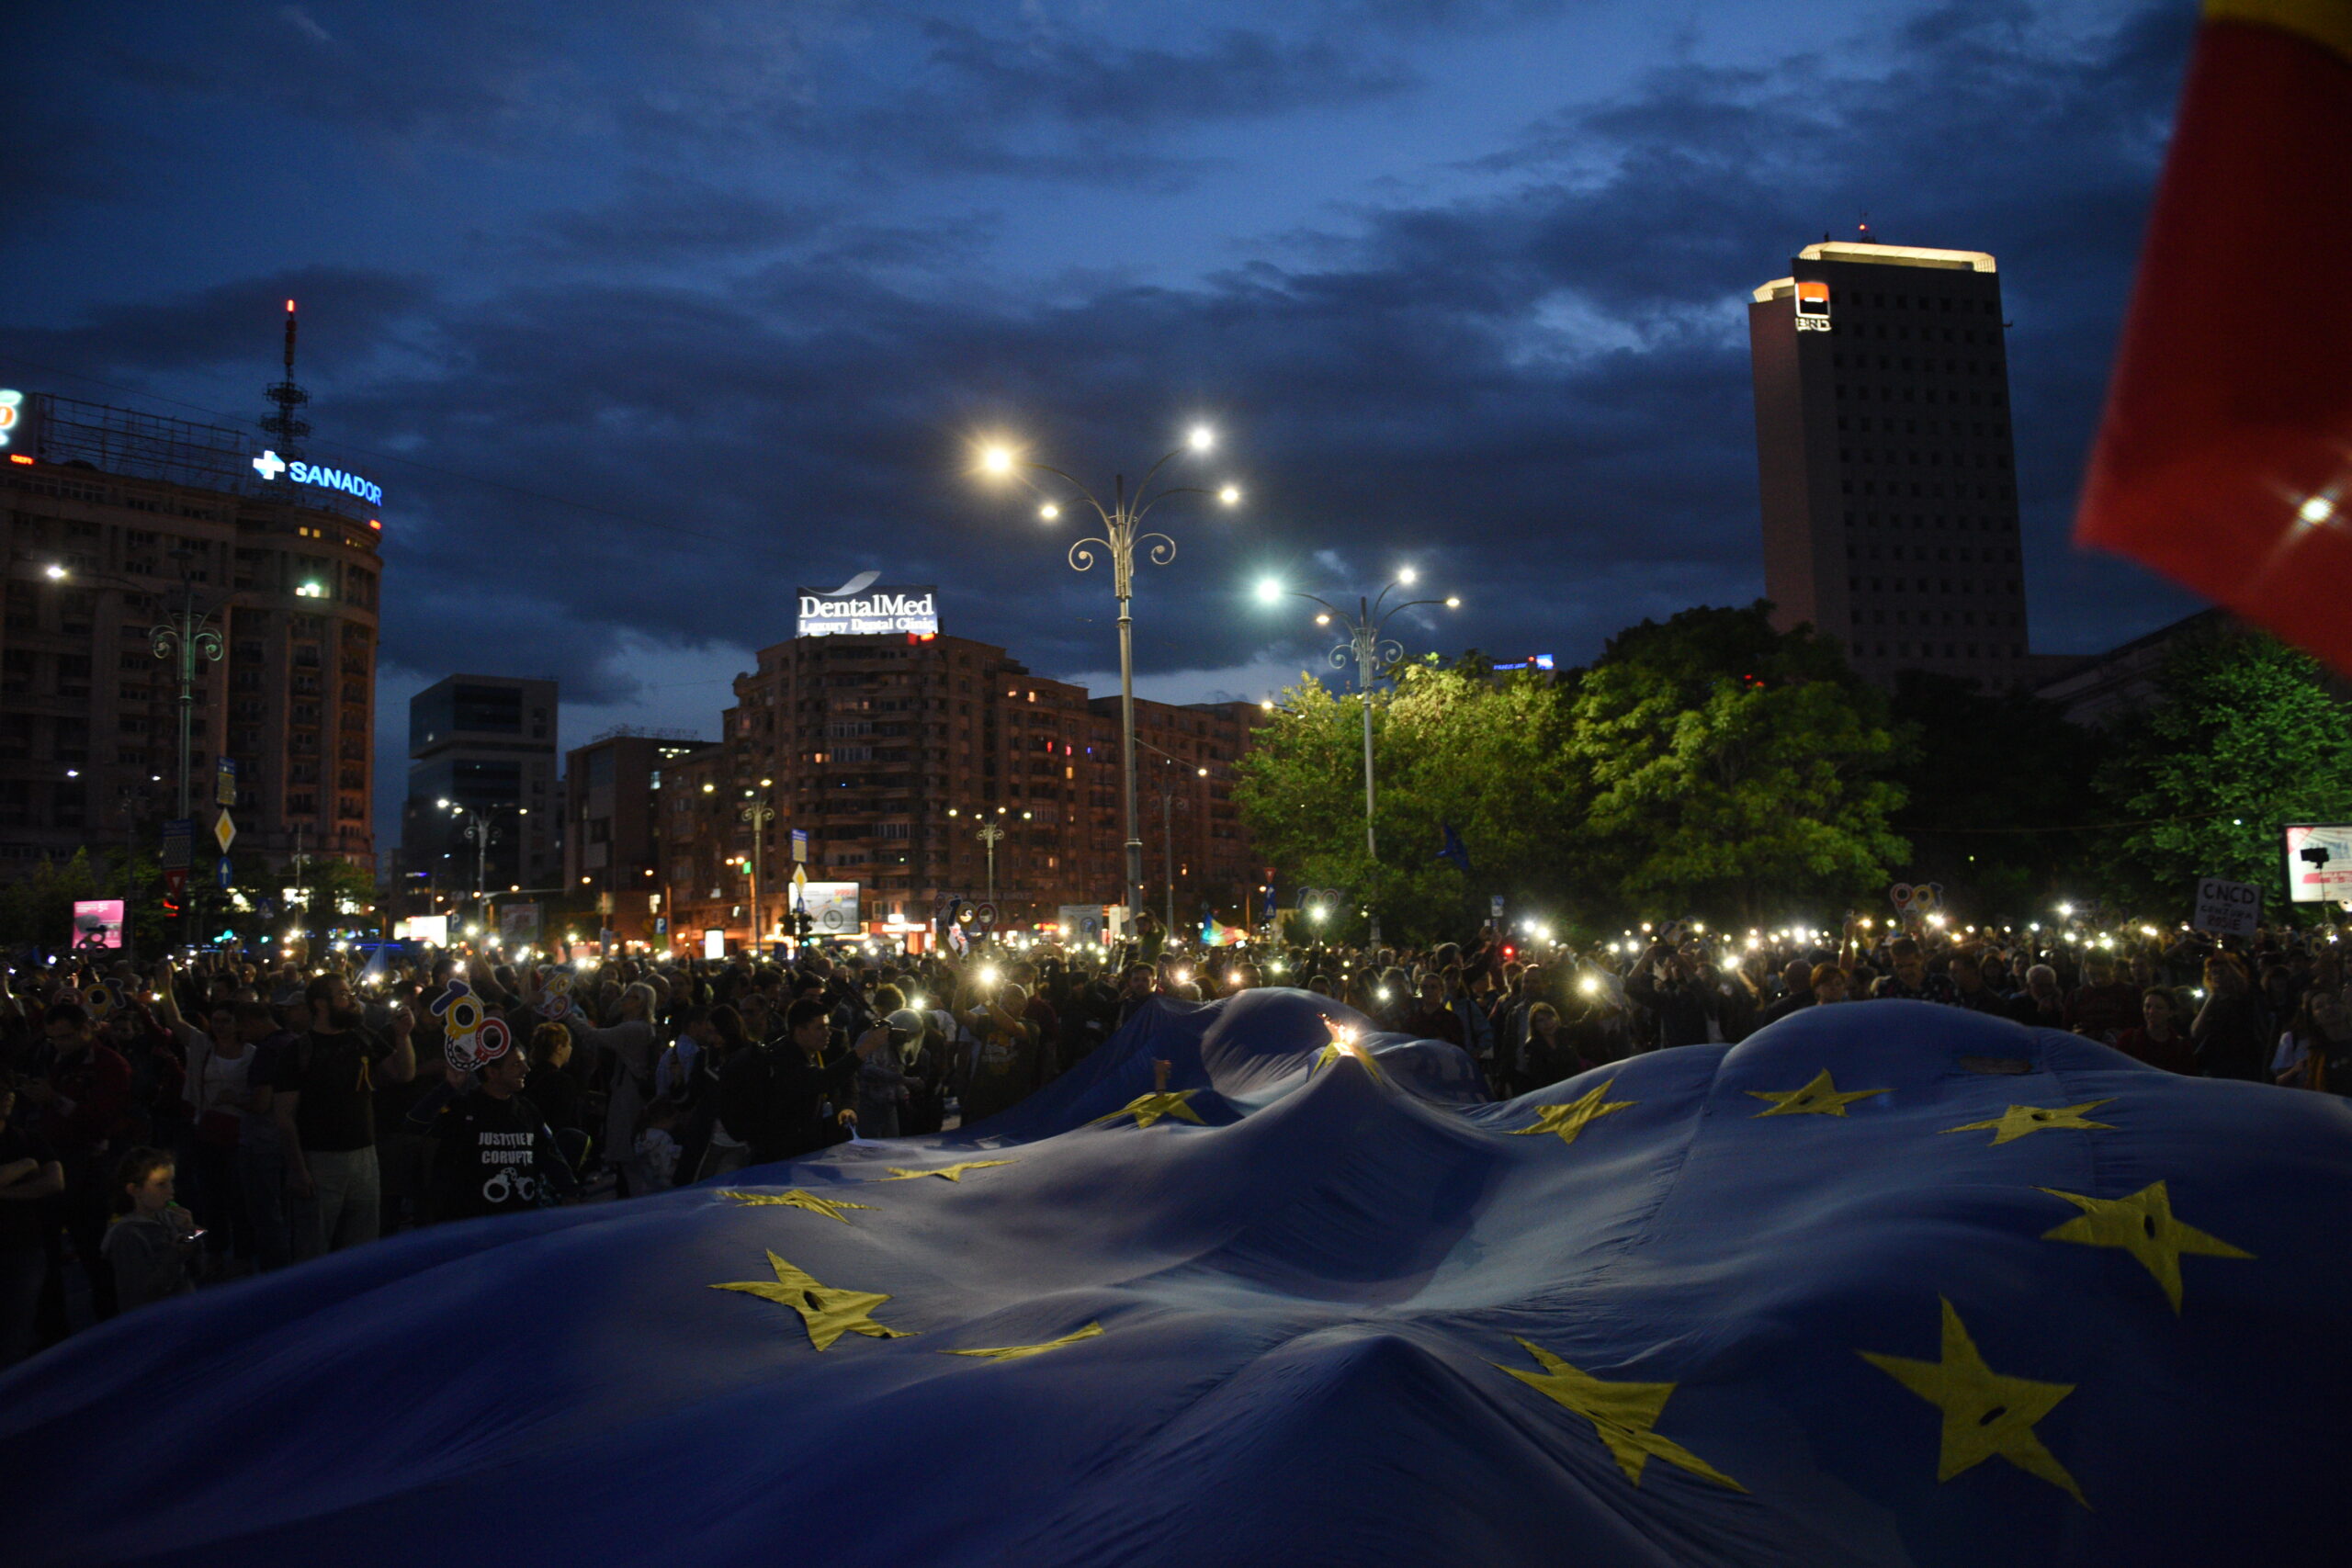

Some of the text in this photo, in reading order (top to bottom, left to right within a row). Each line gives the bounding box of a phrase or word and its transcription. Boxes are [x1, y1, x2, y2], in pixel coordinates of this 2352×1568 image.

[289, 461, 381, 506] SANADOR
[799, 593, 934, 617] DentalMed
[851, 618, 894, 631] Dental
[896, 616, 935, 630] Clinic
[2203, 883, 2255, 904] CNCD
[656, 918, 665, 934] P
